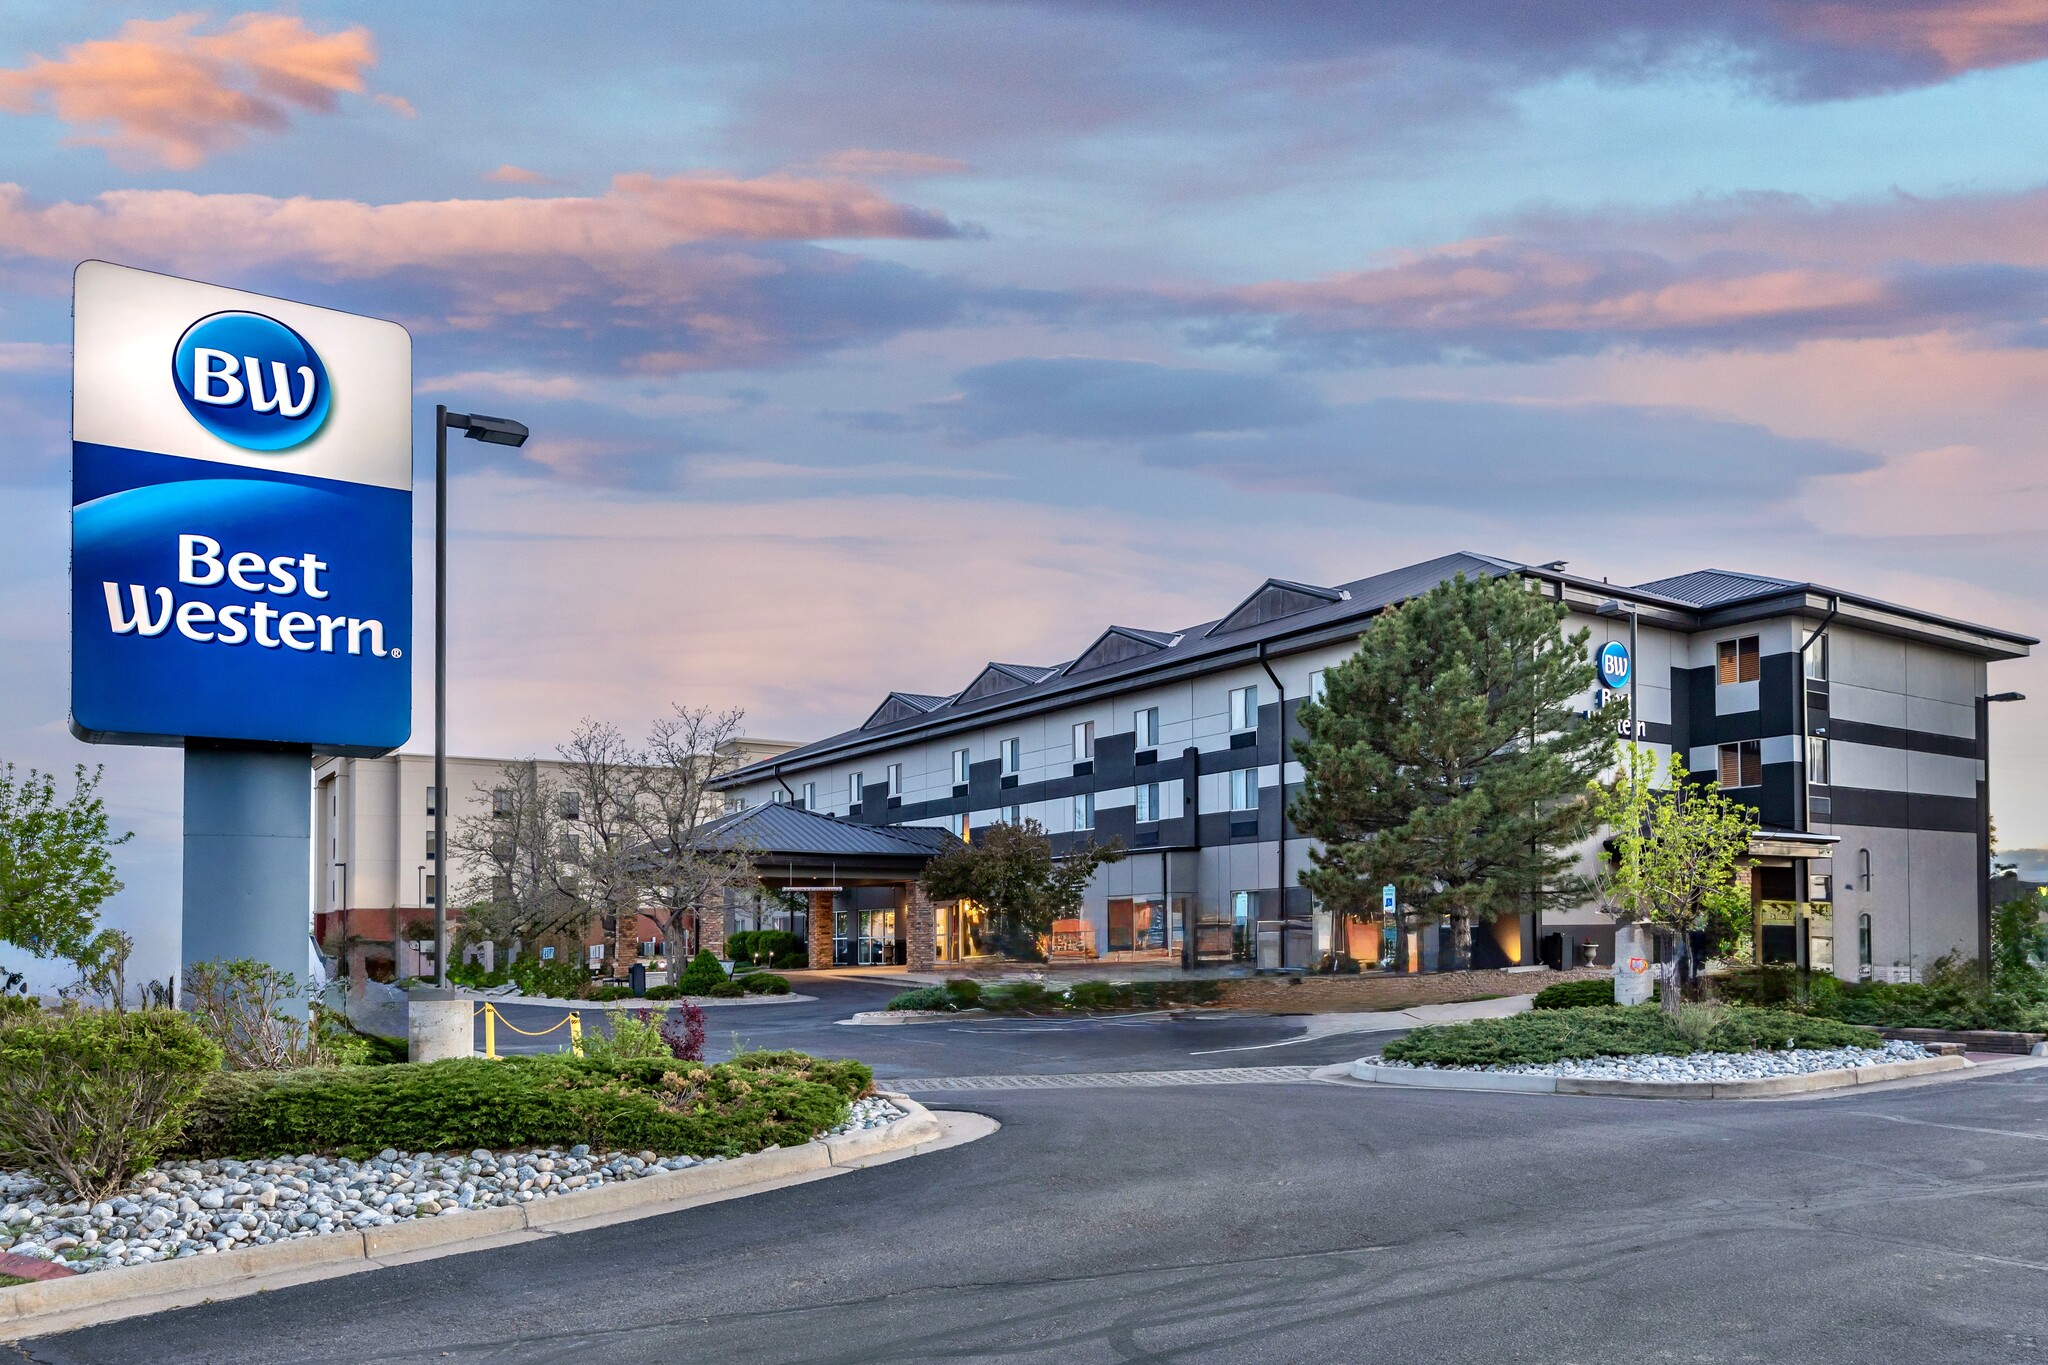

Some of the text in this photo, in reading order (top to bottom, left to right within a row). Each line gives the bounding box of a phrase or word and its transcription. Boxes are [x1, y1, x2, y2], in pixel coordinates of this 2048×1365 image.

[194, 347, 316, 417] BW
[178, 534, 329, 599] Best
[1604, 654, 1628, 677] BW
